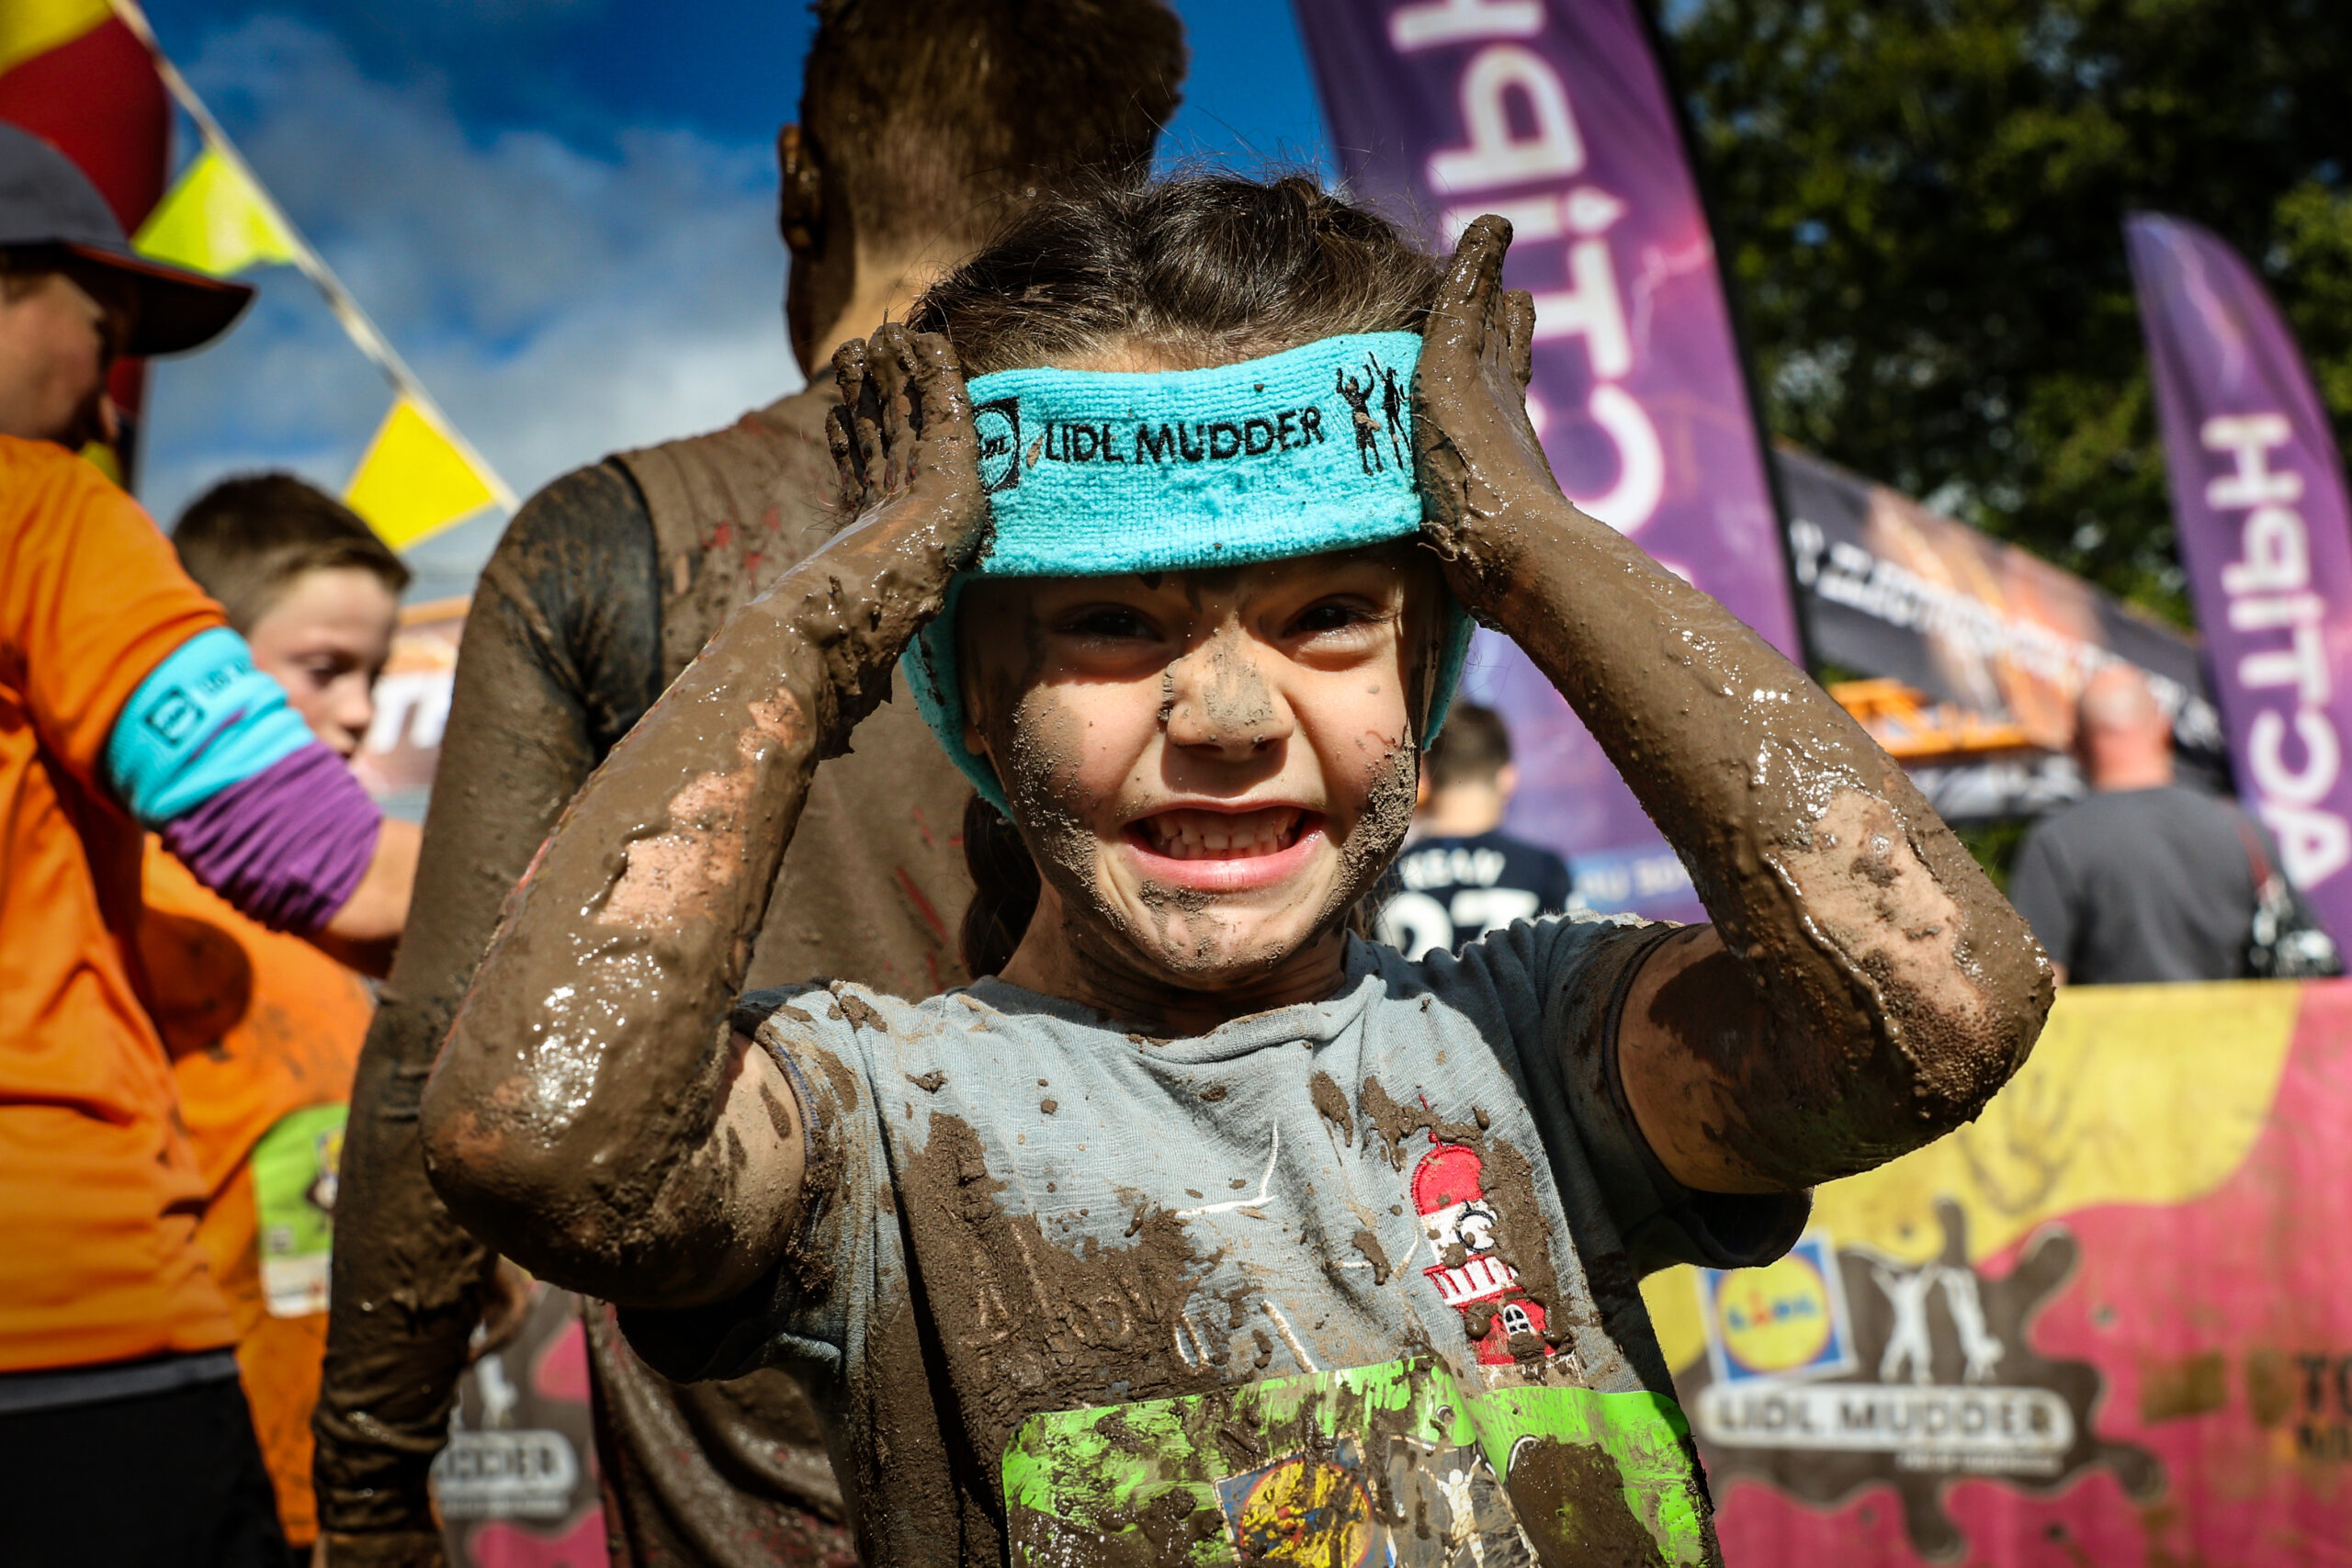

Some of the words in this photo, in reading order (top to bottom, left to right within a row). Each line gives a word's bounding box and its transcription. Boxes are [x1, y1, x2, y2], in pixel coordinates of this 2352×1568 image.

[1046, 423, 1125, 463] LIDL
[1136, 406, 1325, 464] MUDDER
[1718, 1399, 1823, 1435] LIDL
[1840, 1401, 2054, 1439] MUDDER
